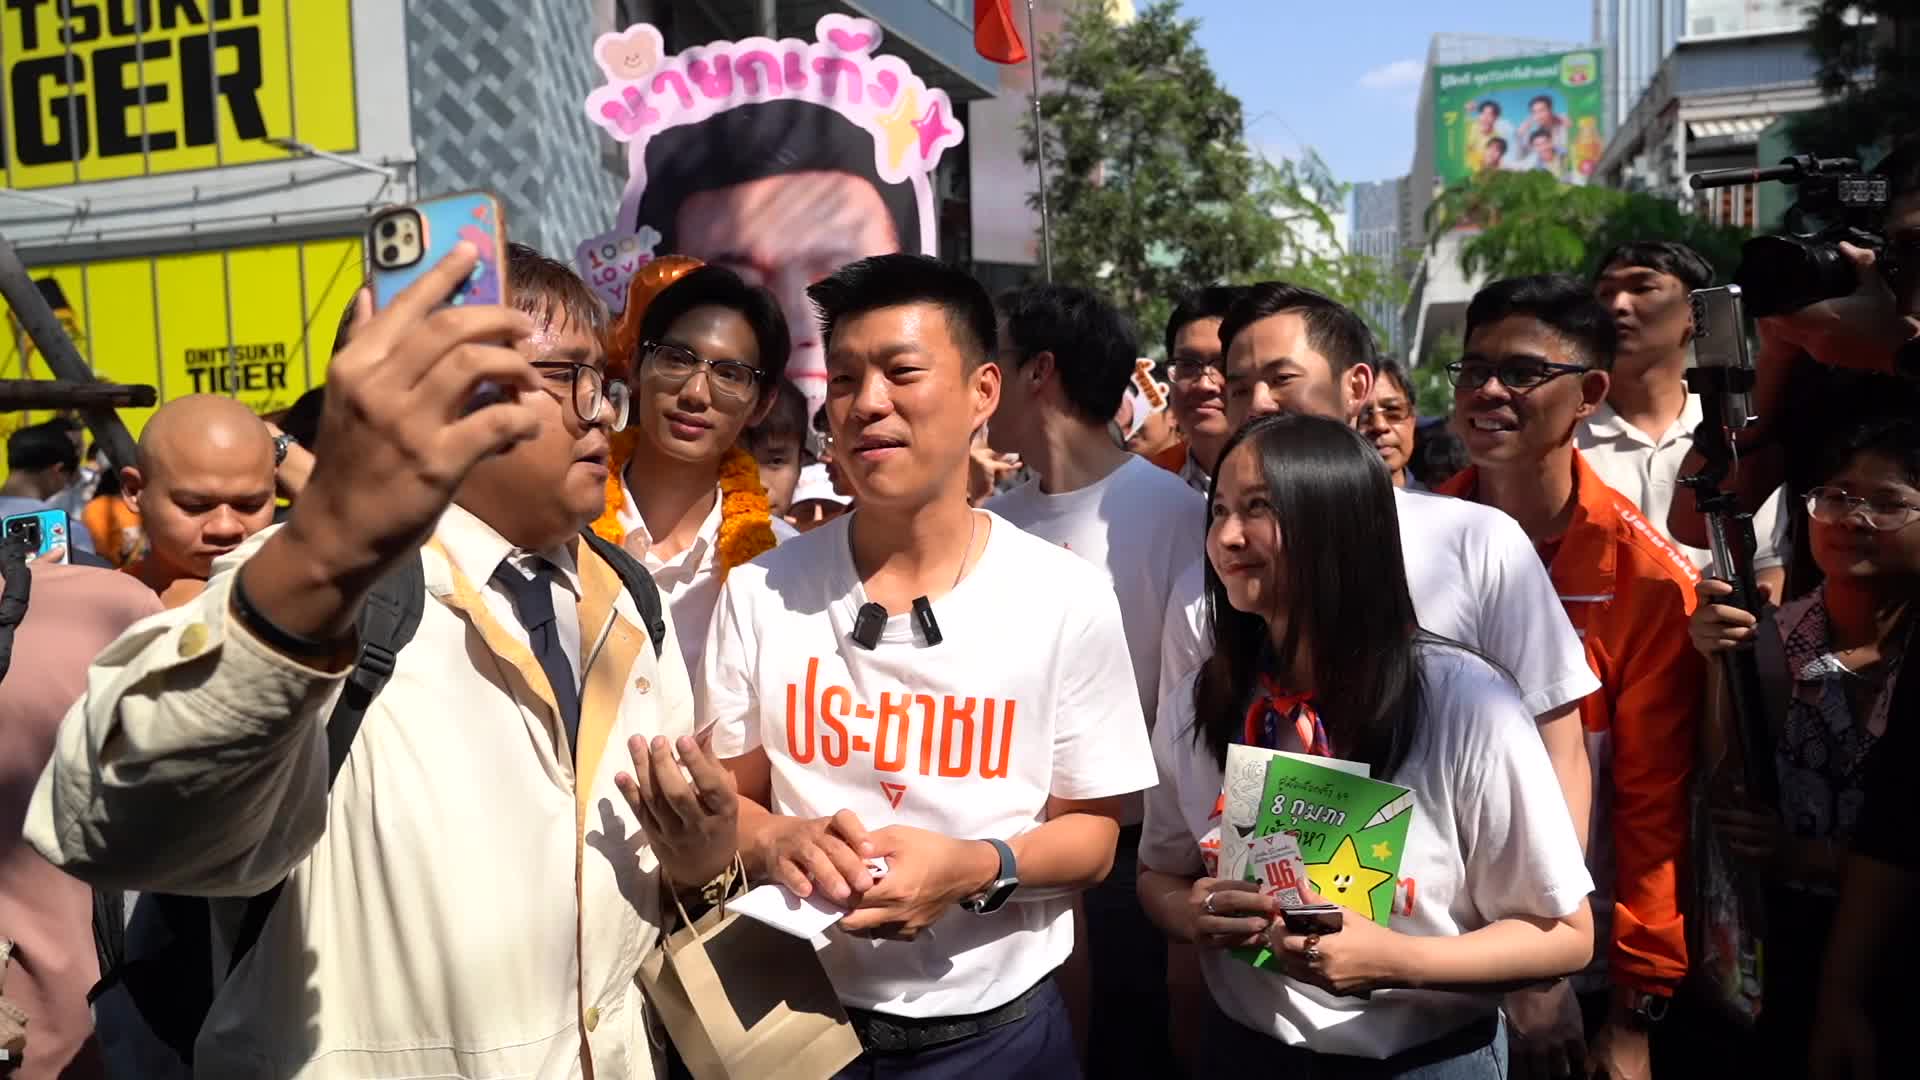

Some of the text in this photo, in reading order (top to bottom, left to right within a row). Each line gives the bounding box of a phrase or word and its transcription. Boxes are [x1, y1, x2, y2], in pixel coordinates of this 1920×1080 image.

[0, 26, 267, 168] GER
[185, 343, 285, 364] ONITSUKA
[187, 362, 286, 394] TIGER
[786, 657, 1016, 779] ประชาชน
[1270, 793, 1347, 827] 8 กุมภา
